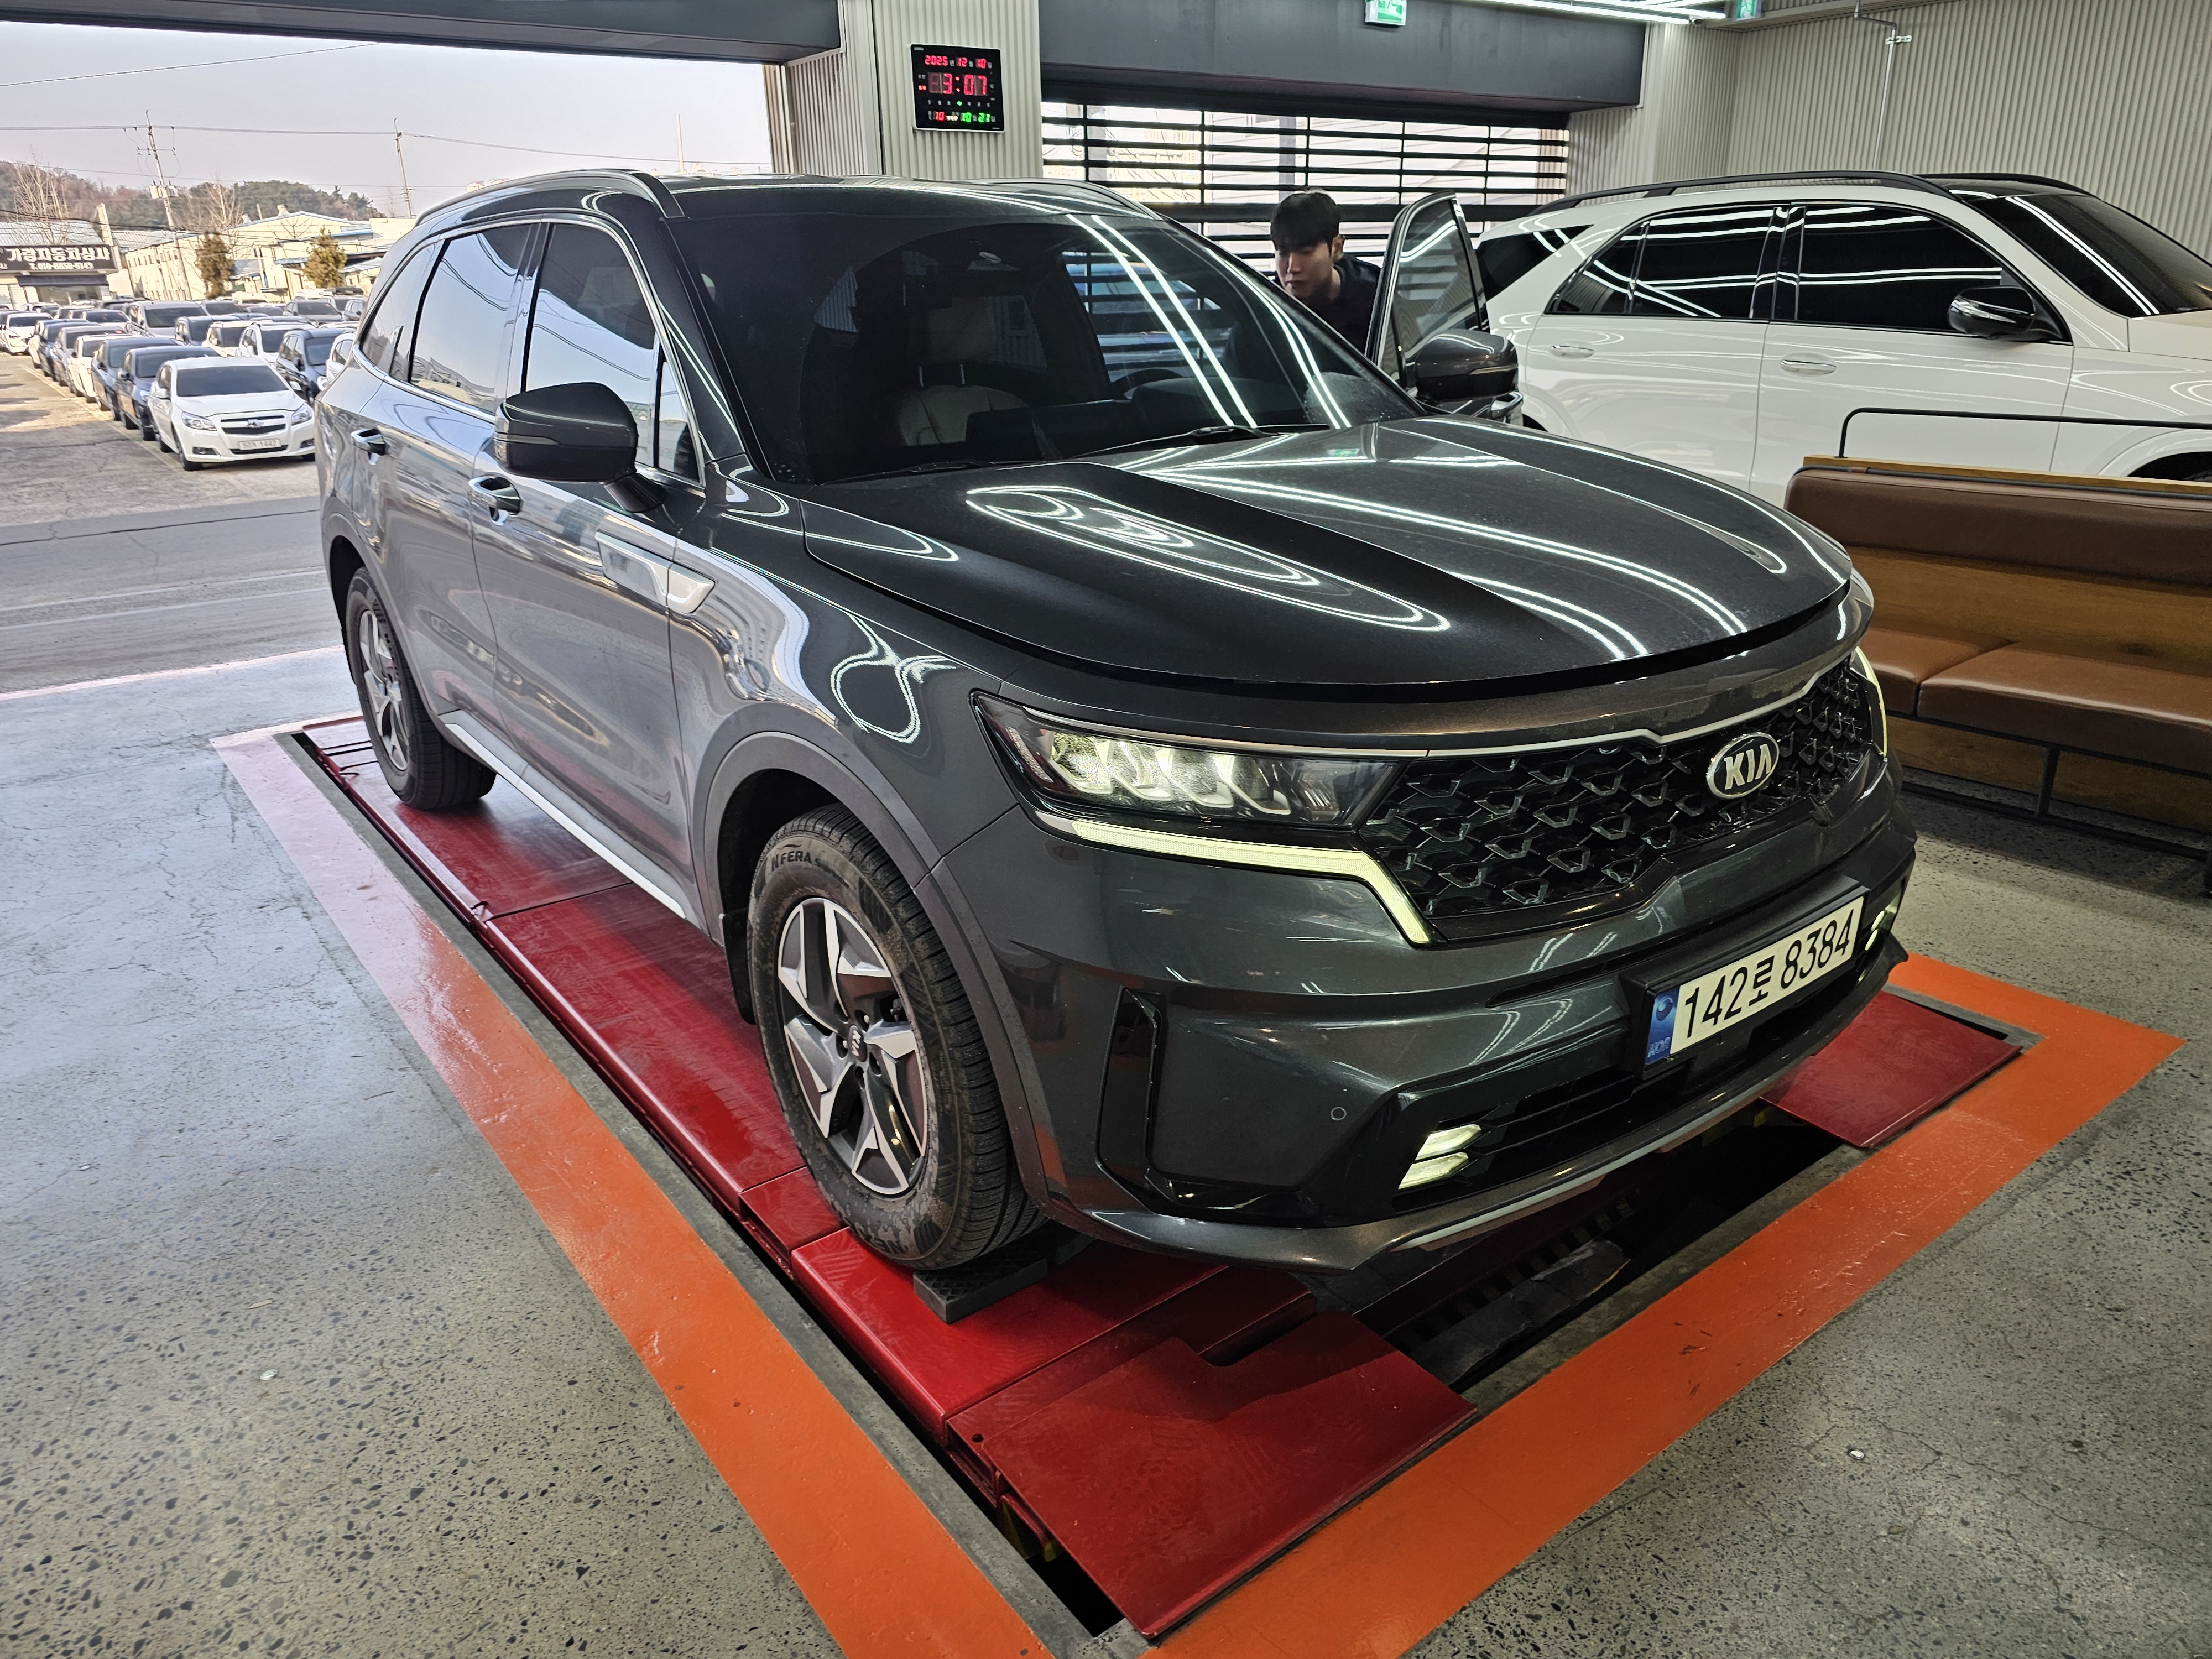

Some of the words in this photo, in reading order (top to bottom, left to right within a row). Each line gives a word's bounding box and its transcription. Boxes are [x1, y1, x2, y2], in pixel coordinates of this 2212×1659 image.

[925, 55, 948, 66] 2025
[958, 57, 968, 67] 12
[943, 73, 987, 95] 3:07
[1724, 743, 1772, 790] KIA
[1685, 954, 1775, 1039] 142로
[1780, 908, 1854, 989] 8384
[852, 1030, 862, 1057] KIA
